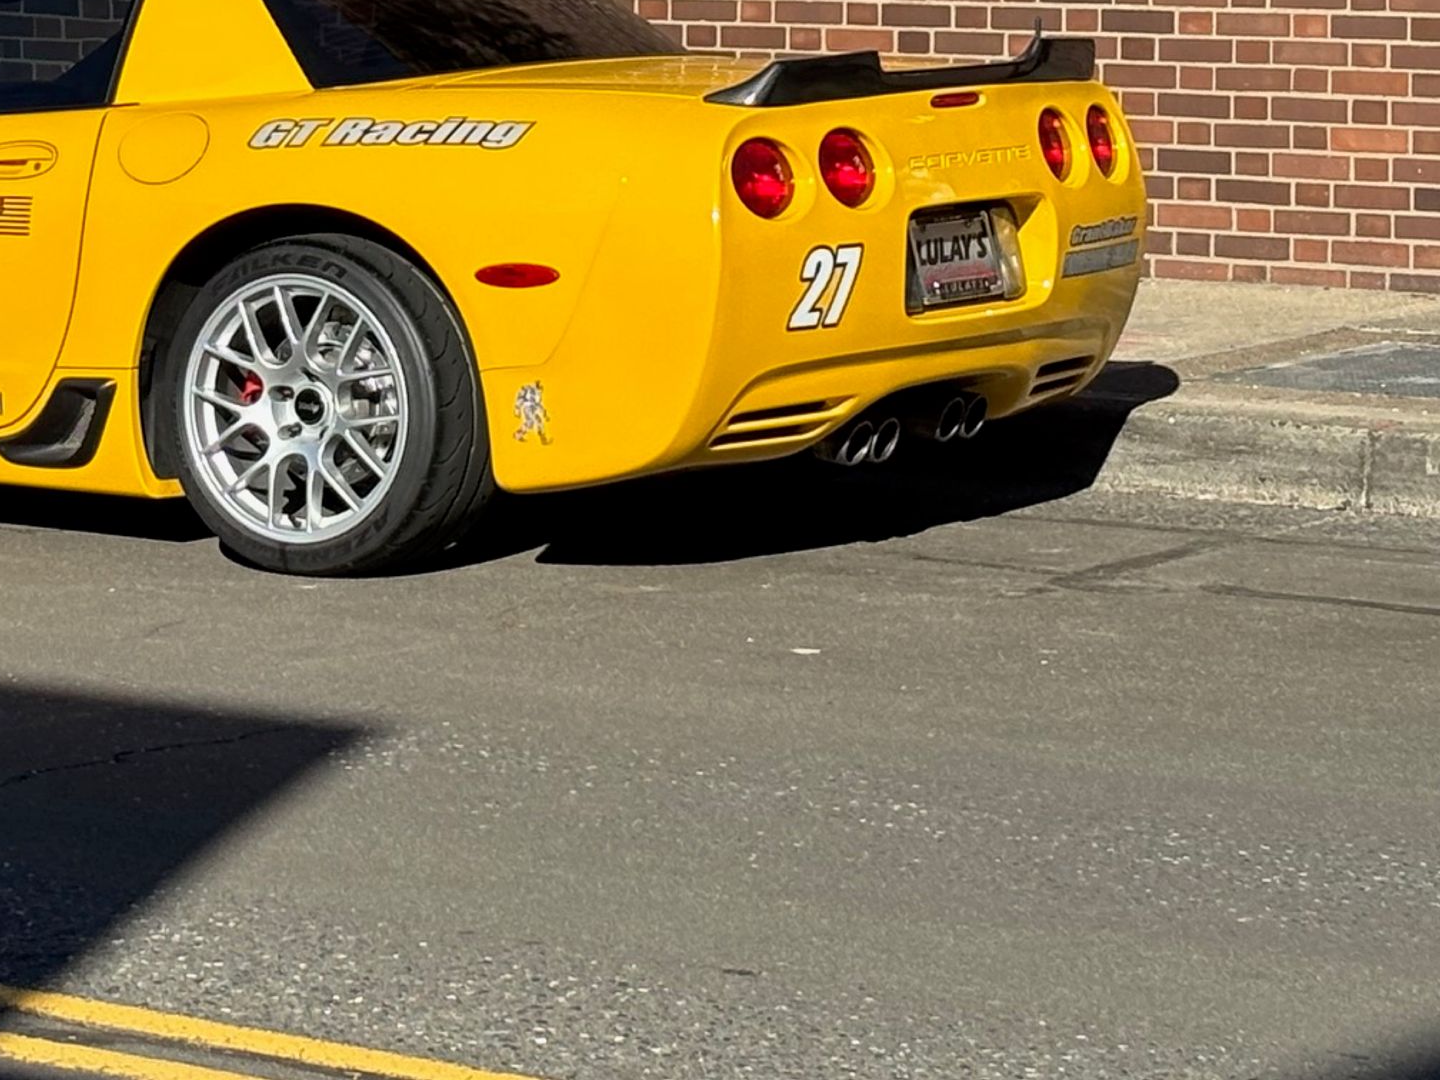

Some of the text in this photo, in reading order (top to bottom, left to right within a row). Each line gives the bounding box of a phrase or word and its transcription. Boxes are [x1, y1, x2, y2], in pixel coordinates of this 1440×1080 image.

[247, 116, 536, 150] GT Racing
[786, 243, 864, 332] 27
